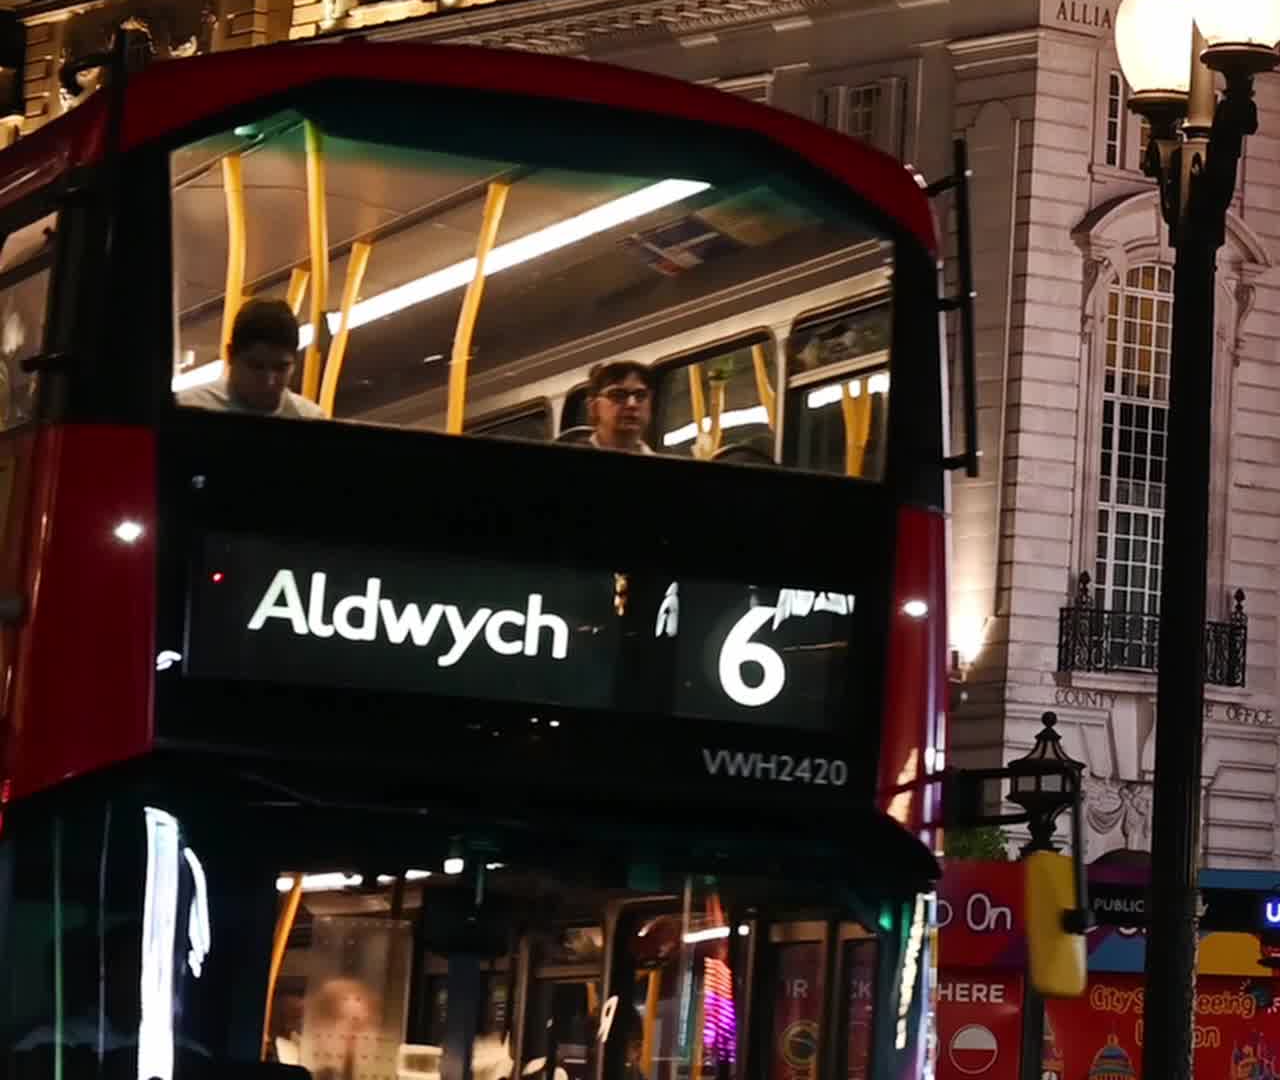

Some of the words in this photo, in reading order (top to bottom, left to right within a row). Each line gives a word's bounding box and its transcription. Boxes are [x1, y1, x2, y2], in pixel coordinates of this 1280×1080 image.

[247, 569, 569, 667] Aldwych
[719, 605, 785, 707] 6
[1055, 689, 1118, 709] COUNTY
[1226, 704, 1273, 724] OFFICE
[702, 748, 848, 786] VWH2420
[966, 892, 1012, 932] On
[1093, 896, 1145, 913] PUBLIC
[937, 983, 1005, 1003] HERE
